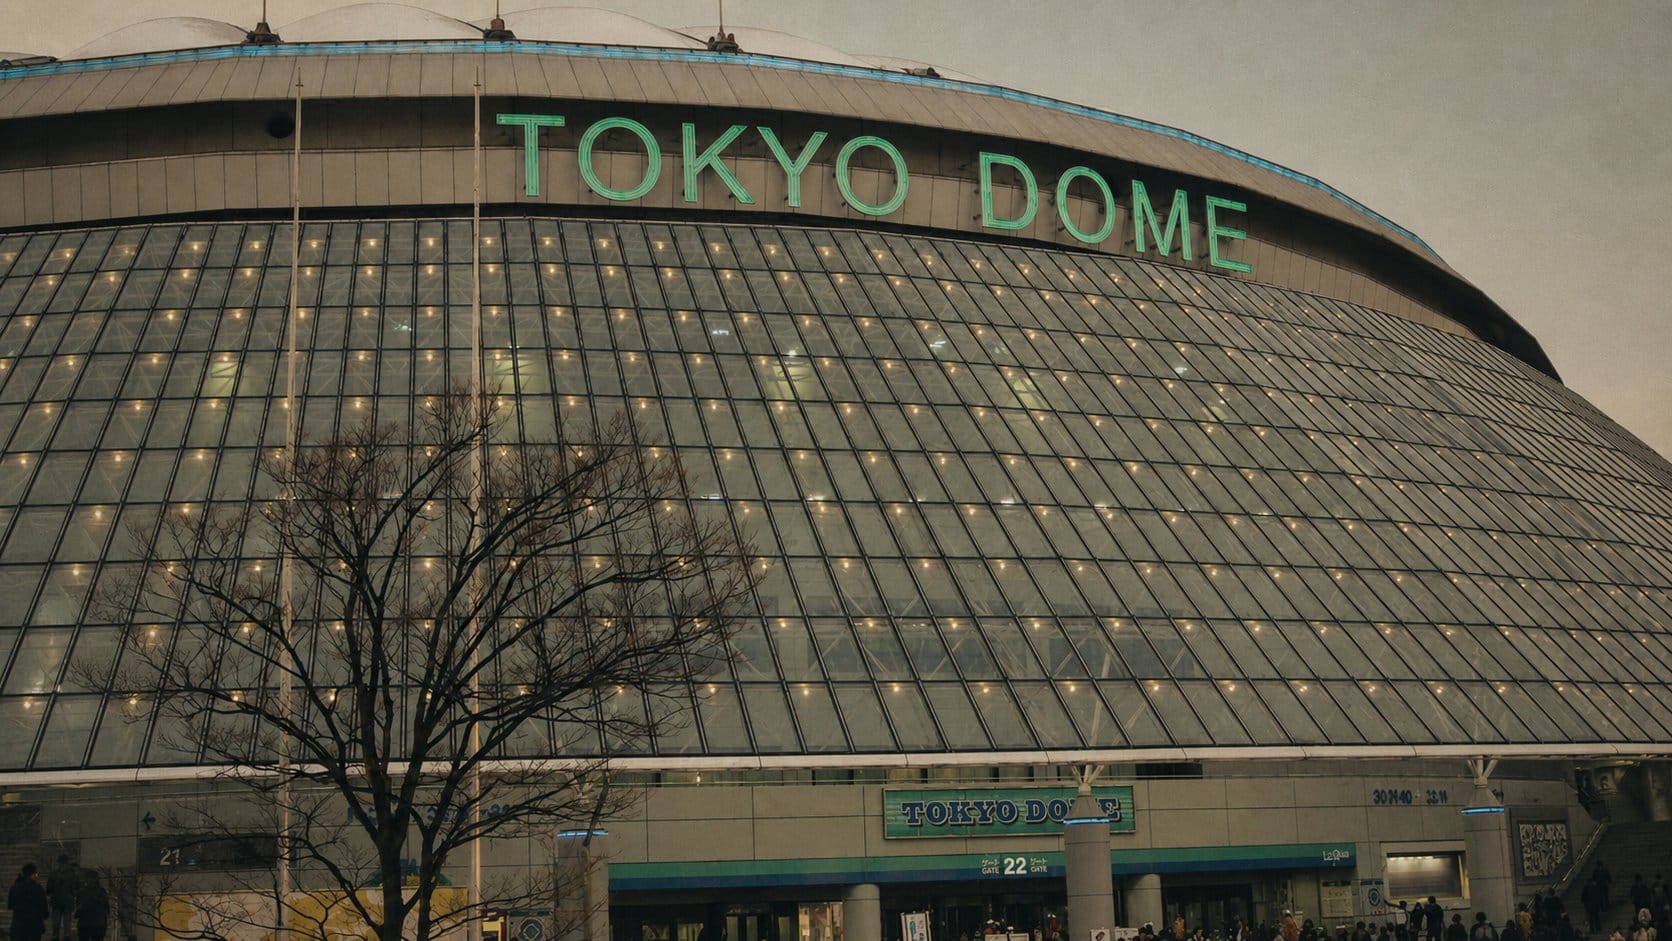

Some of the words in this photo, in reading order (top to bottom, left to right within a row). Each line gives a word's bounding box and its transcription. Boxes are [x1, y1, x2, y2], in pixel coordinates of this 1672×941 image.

[496, 113, 909, 217] TOKYO
[978, 151, 1252, 274] DOME
[901, 800, 1018, 825] TOKYO
[1024, 797, 1120, 823] DOE
[981, 866, 1000, 875] GATE
[1003, 857, 1027, 875] 22
[1030, 865, 1048, 873] GATE
